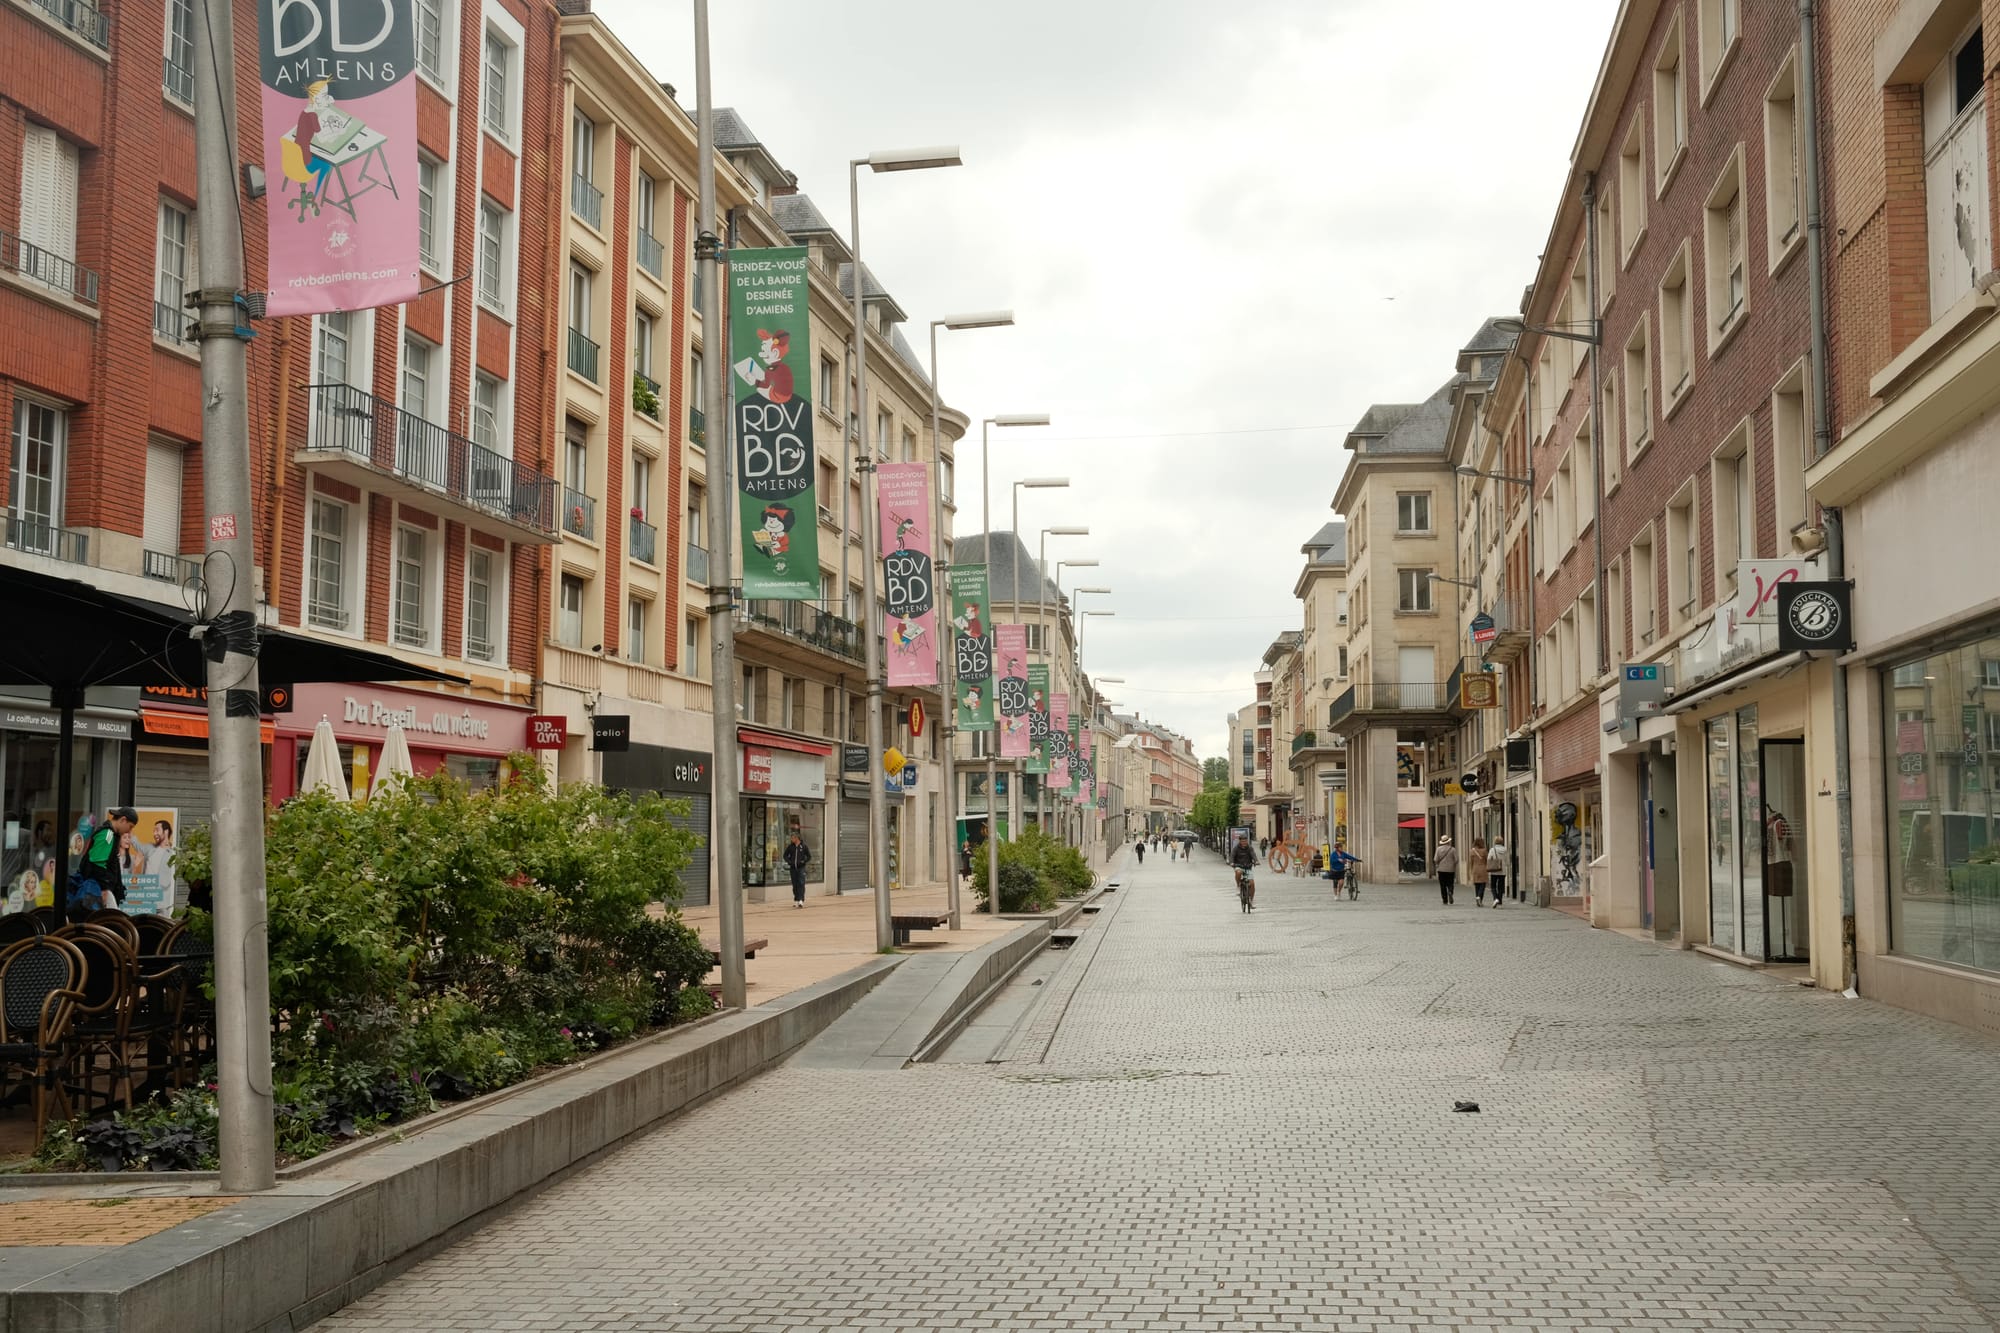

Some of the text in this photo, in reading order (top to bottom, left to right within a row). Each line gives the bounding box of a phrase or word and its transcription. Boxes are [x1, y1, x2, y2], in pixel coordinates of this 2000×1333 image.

[275, 57, 396, 86] AMIENS
[731, 259, 806, 273] RENDEZ-VOUS
[288, 267, 398, 288] rdvbdamiens.com
[737, 275, 802, 287] DE LA BANDE
[746, 288, 793, 301] DESSINÉE
[746, 304, 794, 316] D'AMIENS
[742, 402, 805, 433] RDV
[743, 433, 806, 477] BD
[745, 478, 807, 491] AMIENS
[887, 556, 927, 577] RDV
[888, 576, 928, 605] BD
[890, 604, 929, 614] AMIENS
[1792, 593, 1836, 612] BOUCHARA
[957, 637, 987, 652] RDV
[1629, 669, 1654, 678] CIC
[1000, 681, 1025, 692] RDV
[1001, 692, 1026, 710] BD
[7, 713, 16, 722] La
[16, 714, 40, 725] coiffure
[40, 716, 54, 726] Chic
[73, 719, 88, 729] Choc
[344, 697, 368, 725] Du
[433, 711, 449, 735] au
[450, 708, 489, 740] même
[97, 721, 127, 733] MASCULIN
[596, 729, 621, 737] celio
[537, 732, 561, 744] am
[675, 762, 701, 782] celio
